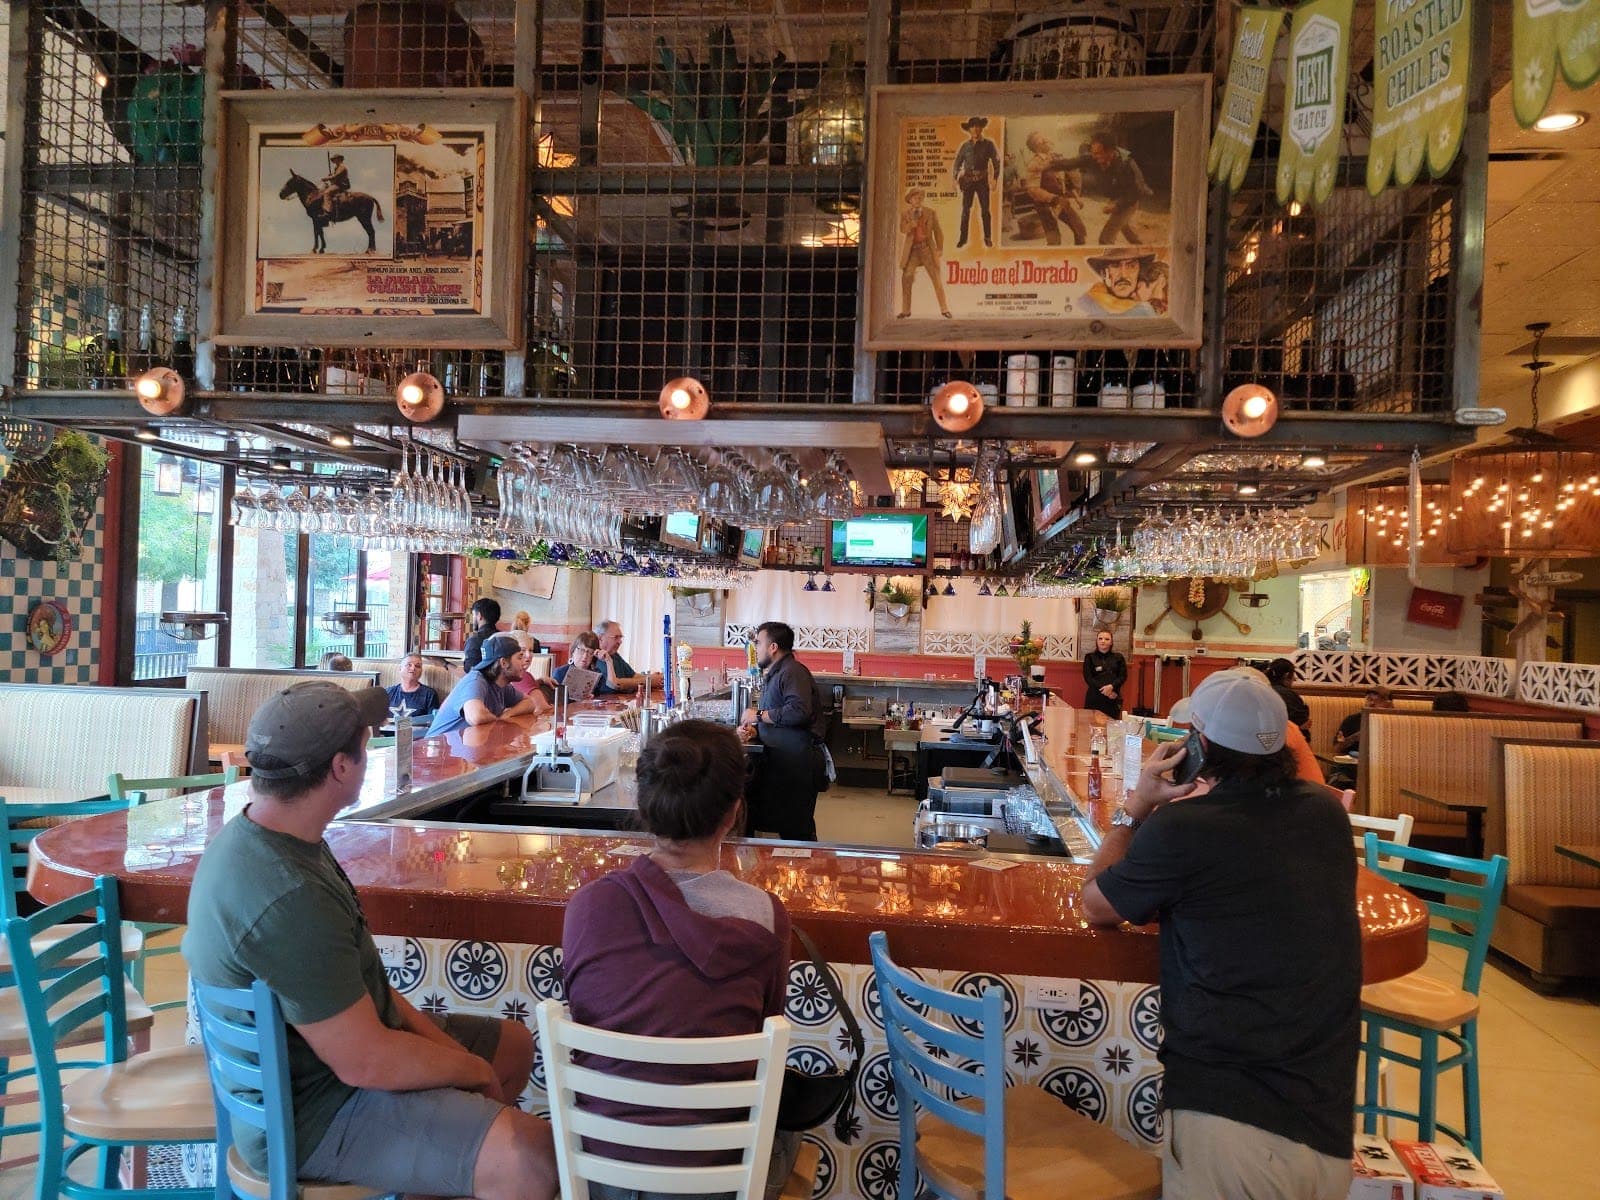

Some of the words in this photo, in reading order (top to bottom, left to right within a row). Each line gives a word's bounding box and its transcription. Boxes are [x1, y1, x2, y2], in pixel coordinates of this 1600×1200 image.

[1379, 0, 1464, 70] ROASTED
[1230, 60, 1265, 94] ROASTED
[1296, 52, 1330, 106] FIESTA
[1386, 39, 1452, 109] CHILES
[1227, 92, 1256, 126] CHILES
[1297, 109, 1328, 131] HATCH
[946, 260, 989, 285] Duelo
[991, 266, 1007, 285] en
[1009, 259, 1021, 286] el
[1021, 259, 1079, 284] Dorado
